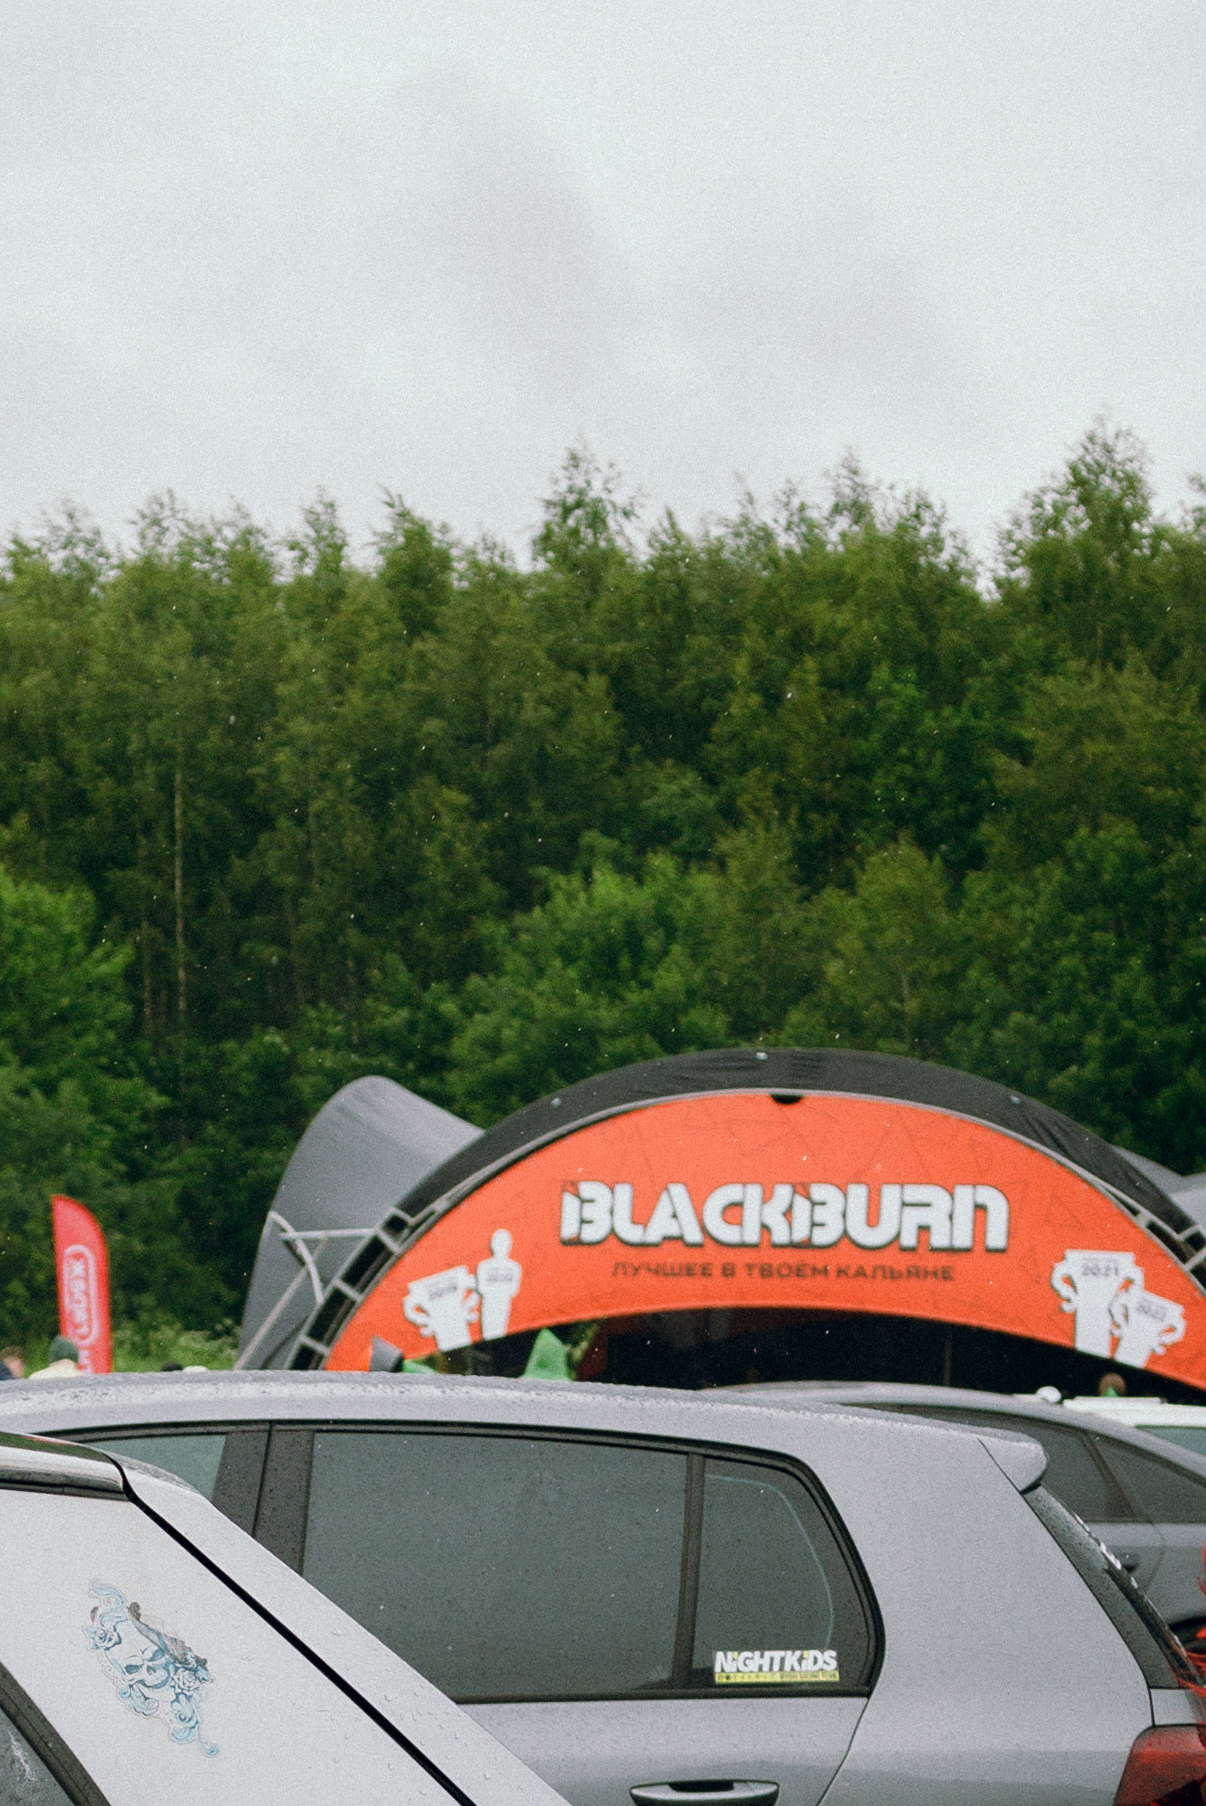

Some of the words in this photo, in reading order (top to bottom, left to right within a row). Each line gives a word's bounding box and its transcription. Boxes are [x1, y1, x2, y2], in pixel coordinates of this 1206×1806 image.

[560, 1181, 1010, 1252] BLACKBURN
[611, 1262, 713, 1279] ЛУЧШЕЕ
[721, 1263, 737, 1279] В
